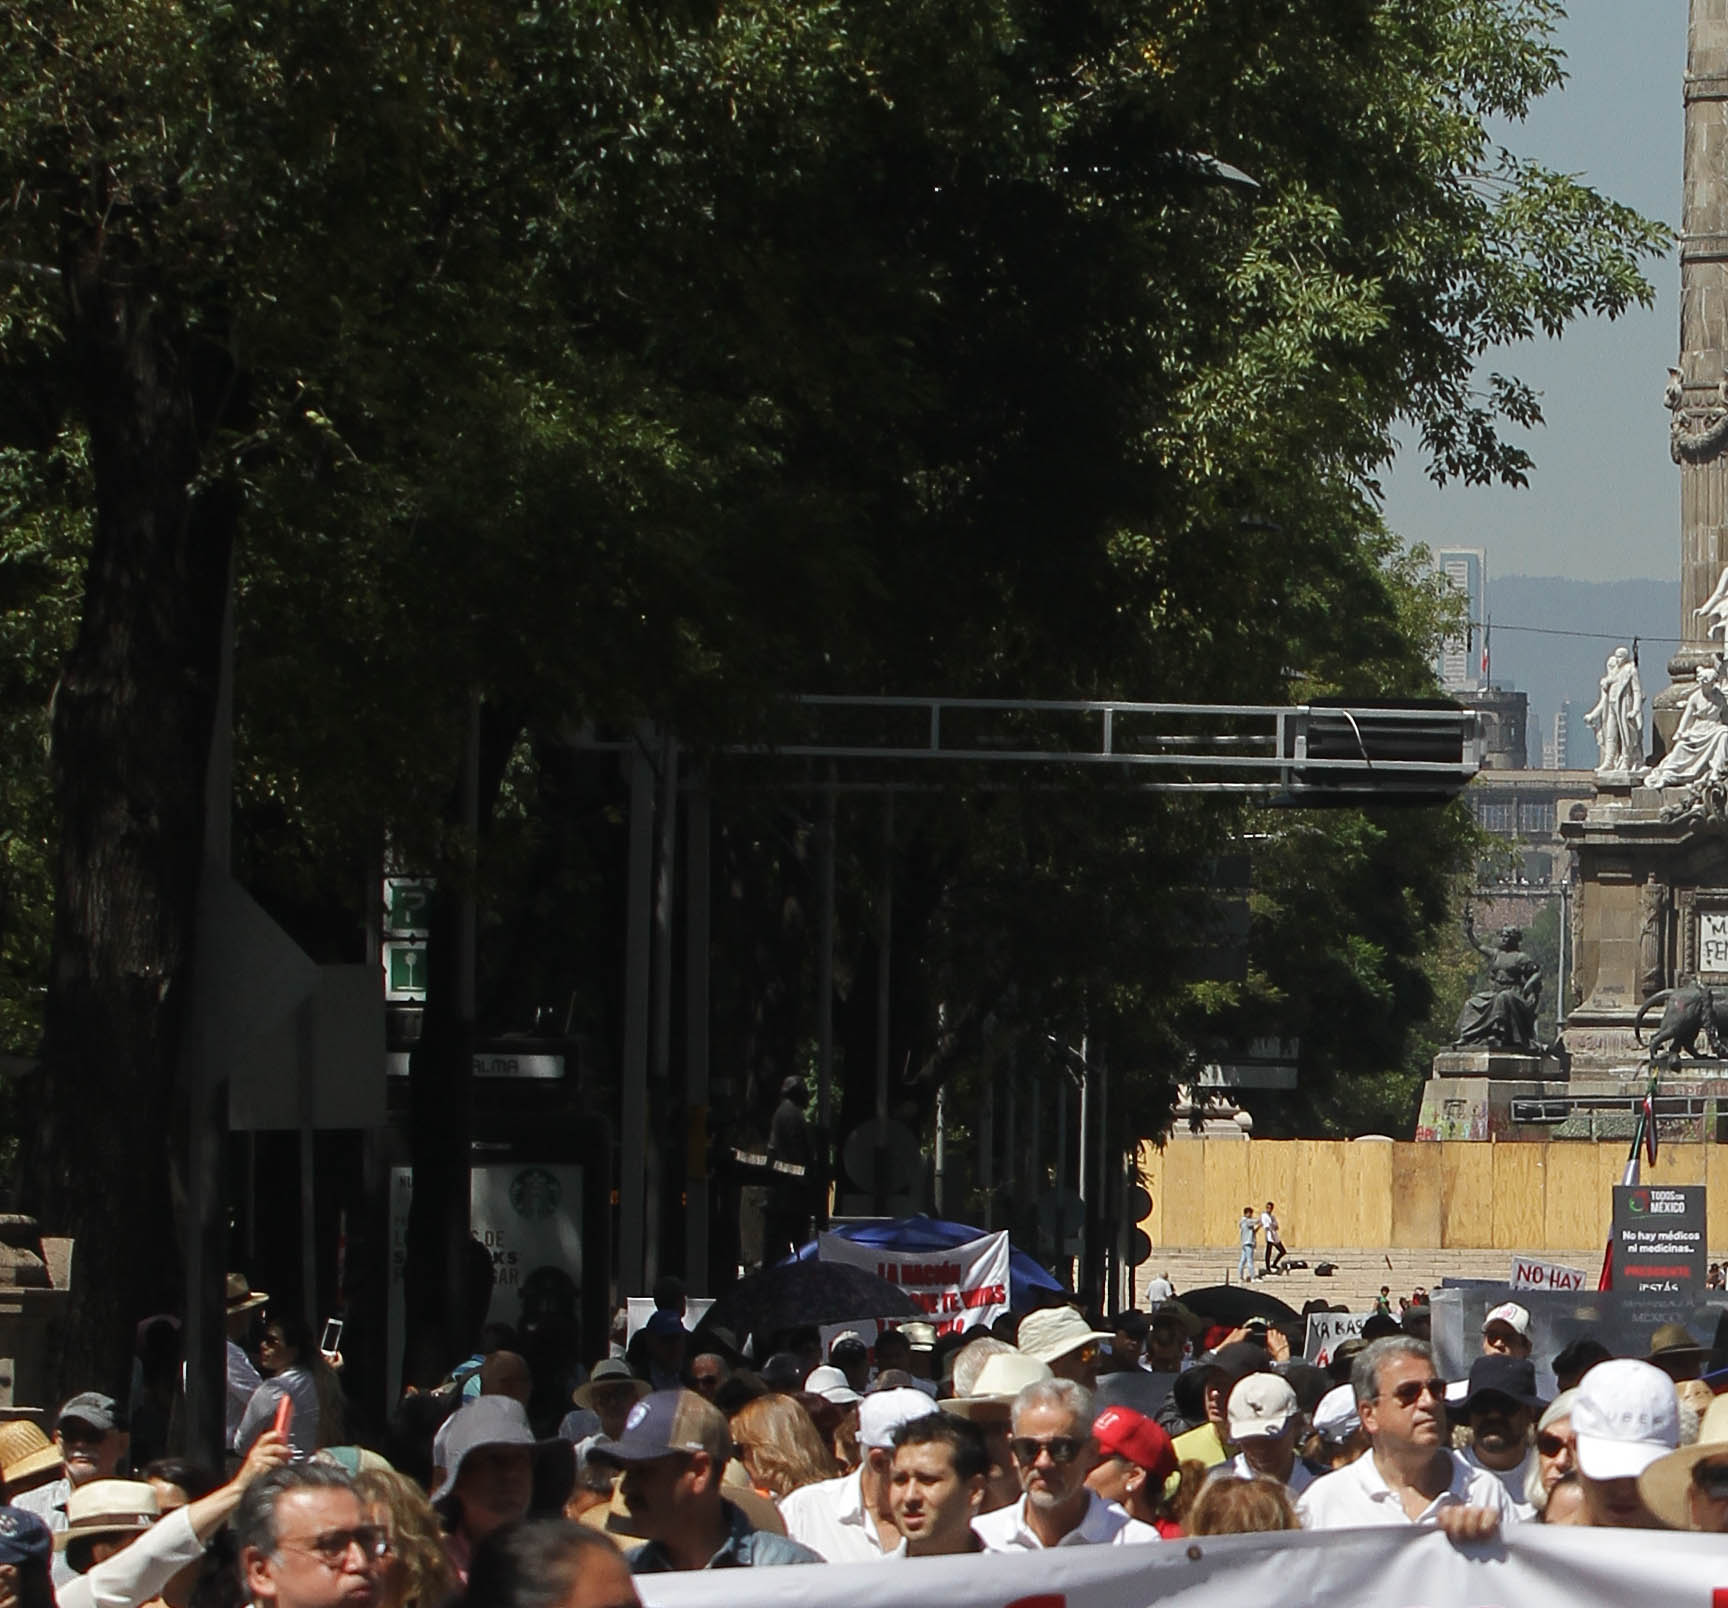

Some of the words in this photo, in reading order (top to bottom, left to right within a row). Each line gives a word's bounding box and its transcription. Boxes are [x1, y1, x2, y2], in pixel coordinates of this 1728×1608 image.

[1650, 1201, 1685, 1213] MÉXICO
[1622, 1230, 1636, 1241] No
[1638, 1230, 1657, 1242] hay
[1658, 1230, 1700, 1241] médicos
[1628, 1244, 1637, 1253] ni
[1516, 1264, 1544, 1283] NO
[1549, 1269, 1582, 1291] HAY
[1311, 1318, 1330, 1339] YA
